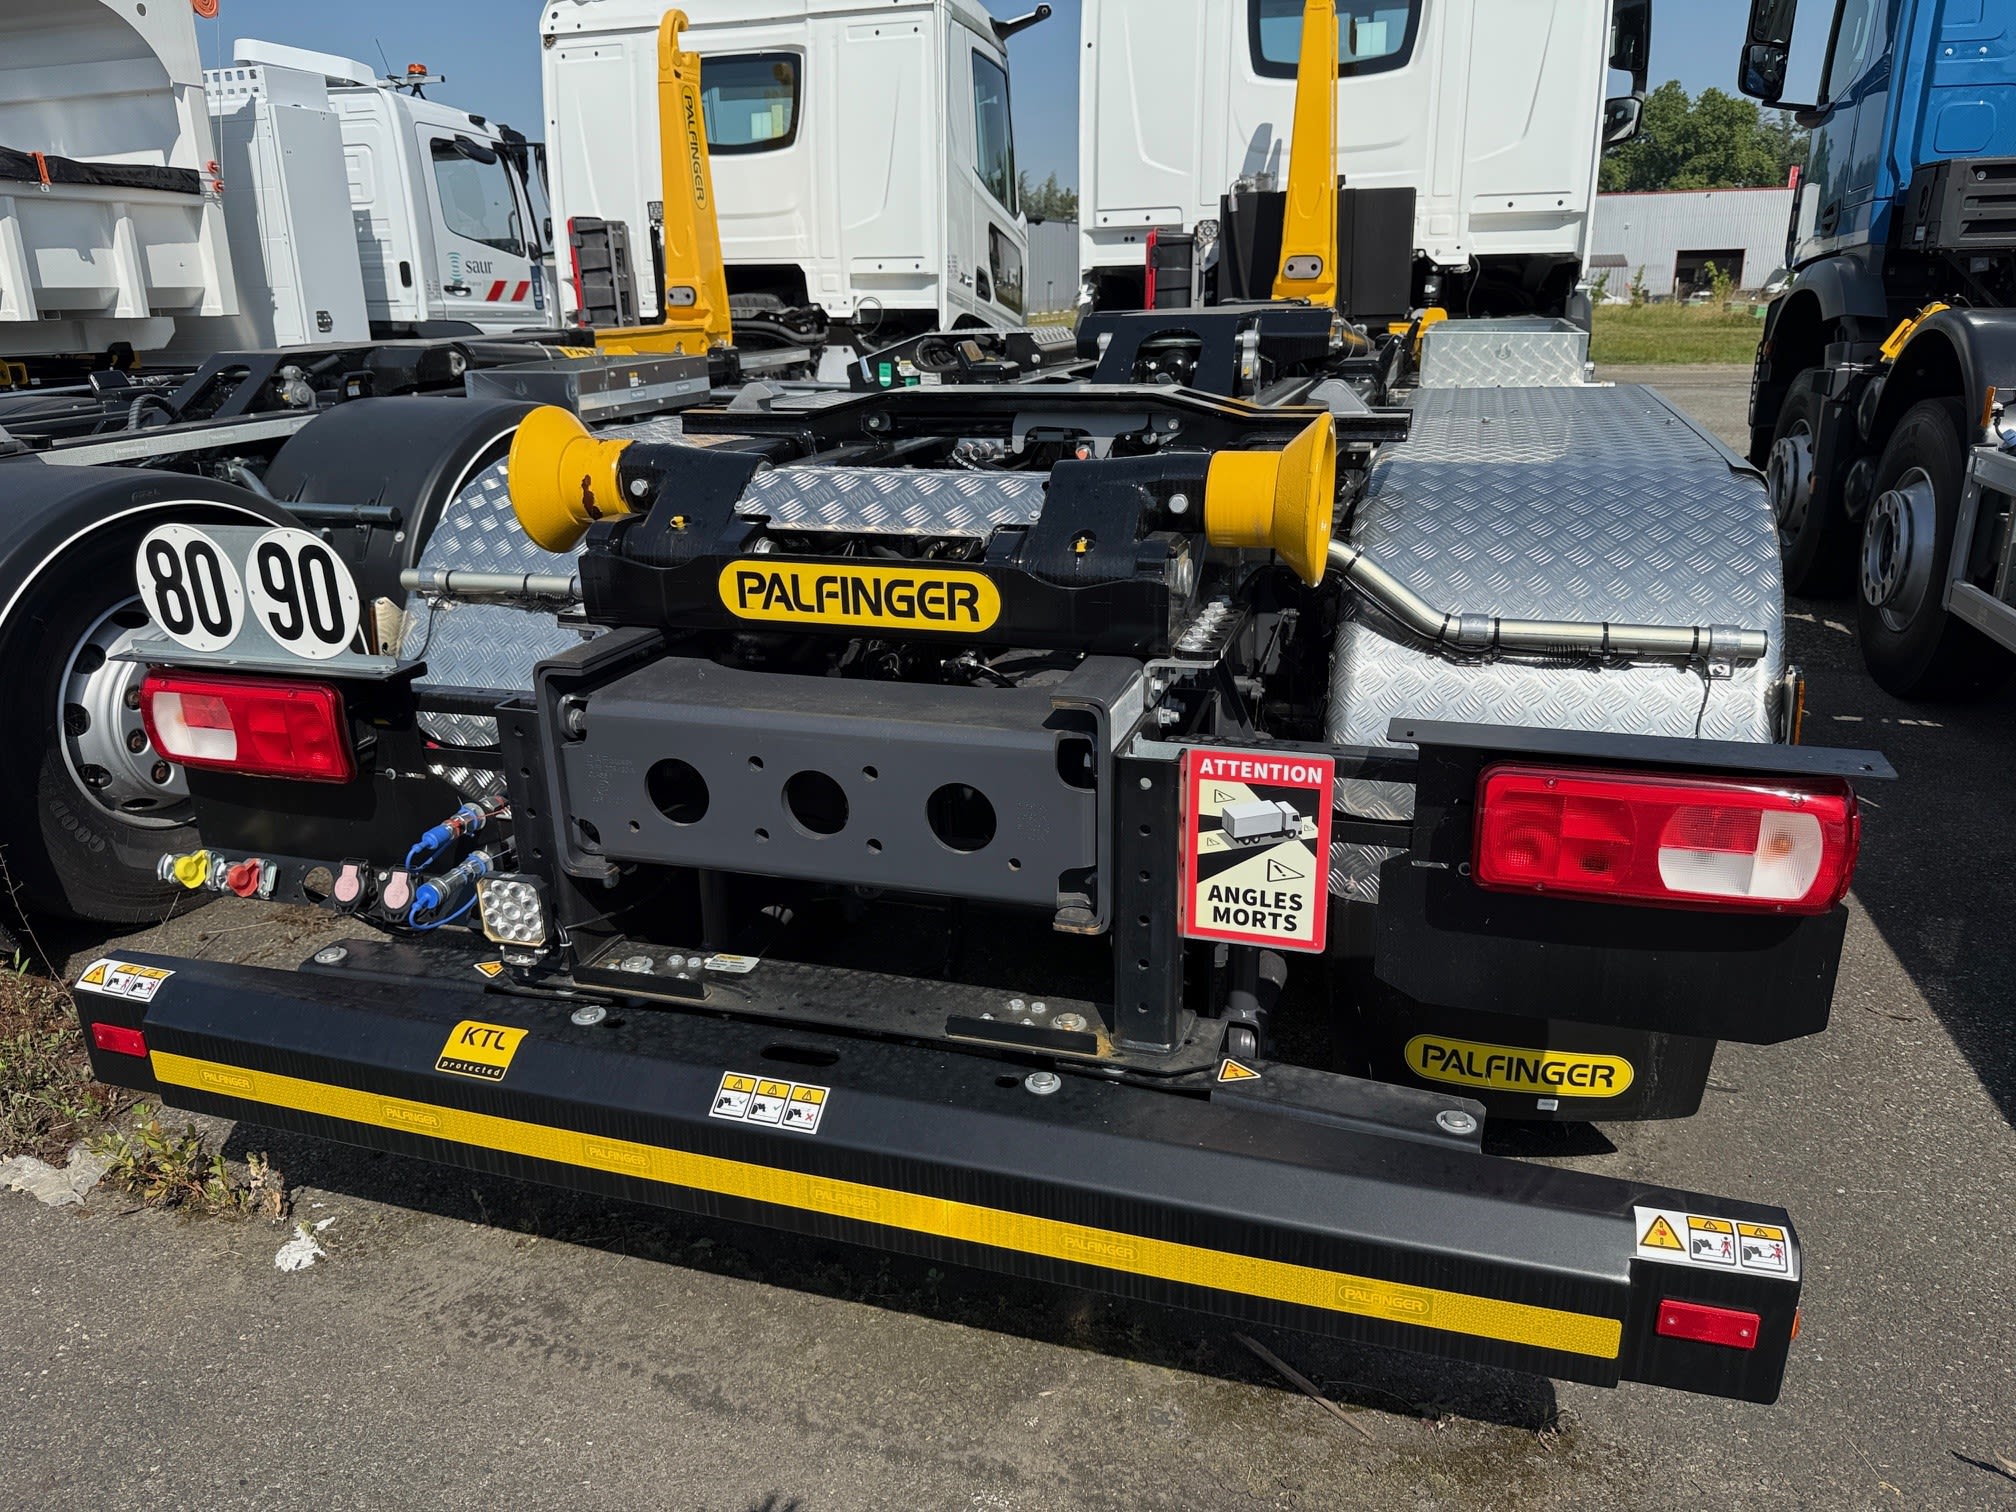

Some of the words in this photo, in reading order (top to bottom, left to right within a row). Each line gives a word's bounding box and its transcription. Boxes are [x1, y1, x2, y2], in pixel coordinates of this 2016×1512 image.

[684, 94, 705, 201] PALFINGER
[465, 260, 493, 274] saur
[146, 539, 232, 637] 80
[257, 541, 345, 644] 90
[736, 570, 980, 623] PALFINGER
[1200, 758, 1323, 785] ATTENTION
[1208, 884, 1303, 911] ANGLES
[1213, 905, 1297, 932] MORTS
[460, 1026, 506, 1051] KTL
[441, 1060, 501, 1077] protected
[1421, 1043, 1616, 1088] PALFINGER
[589, 1146, 646, 1166] PALFINGER
[1065, 1234, 1135, 1260] PALFINGER
[1344, 1287, 1425, 1313] PALFINGER
